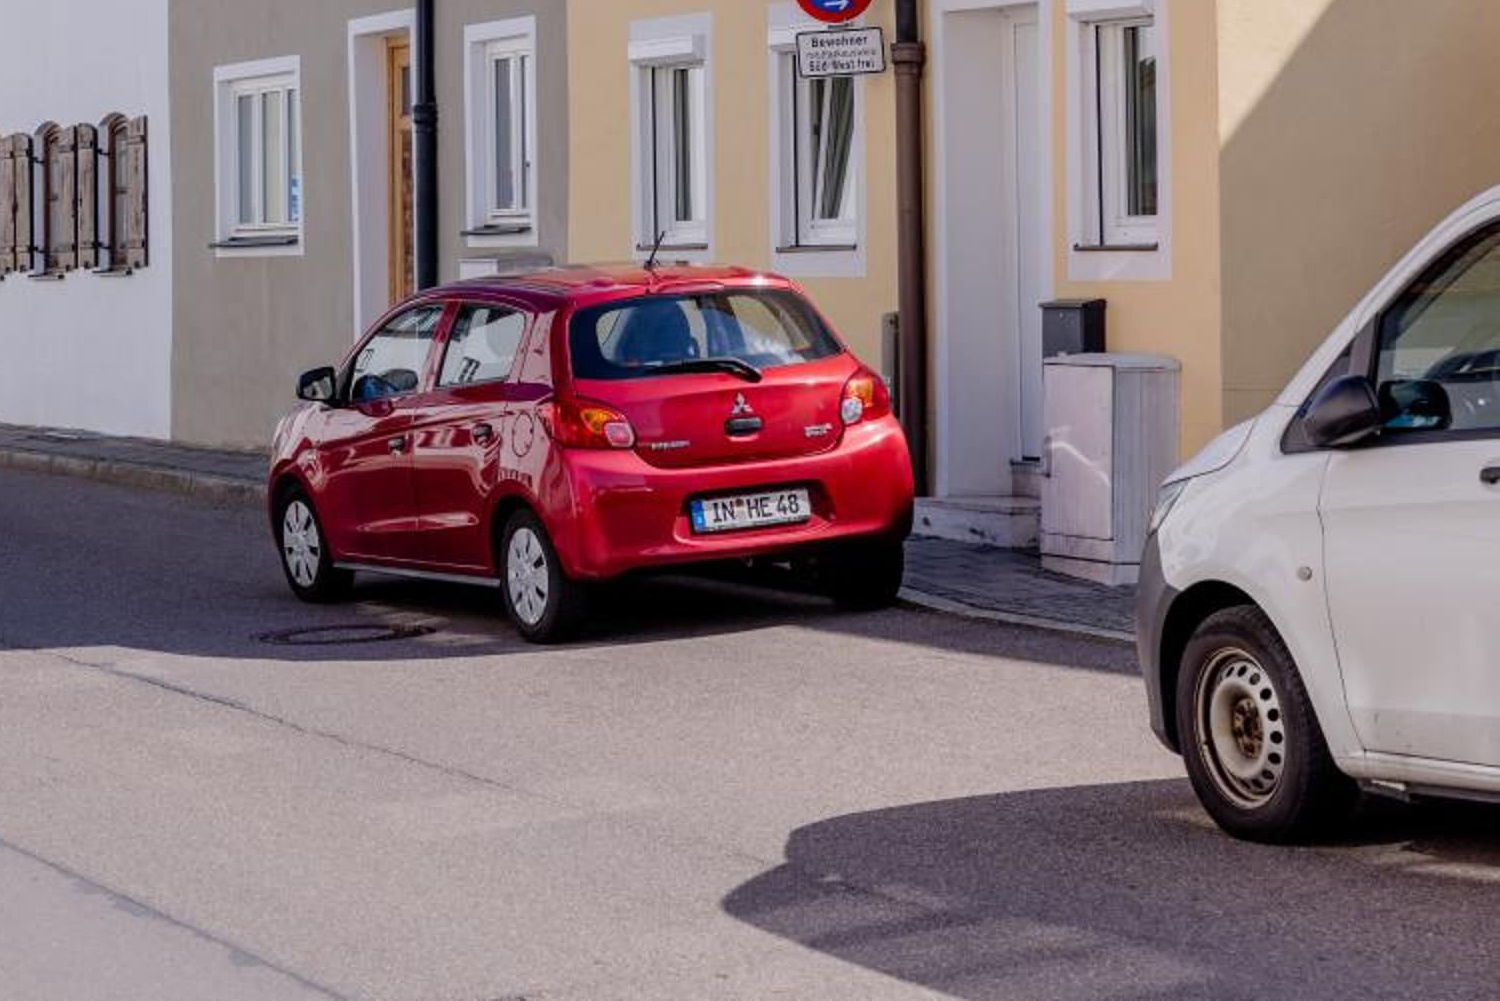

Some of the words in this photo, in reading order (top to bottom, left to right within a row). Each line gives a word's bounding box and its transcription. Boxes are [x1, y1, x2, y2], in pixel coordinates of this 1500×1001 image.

[811, 36, 868, 48] Bewohner
[712, 501, 736, 523] IN
[746, 496, 773, 519] HE
[777, 494, 799, 515] 48
